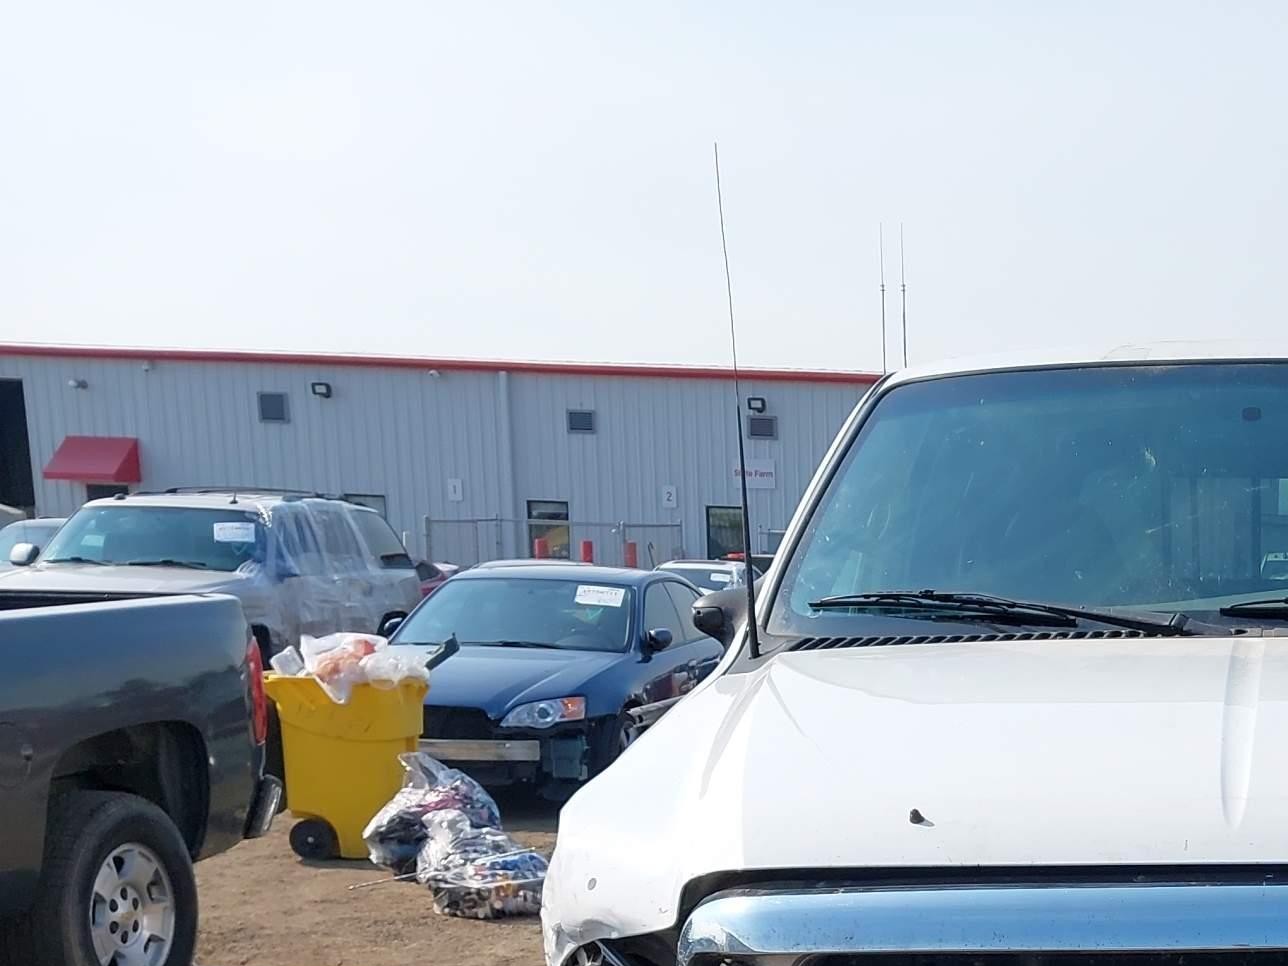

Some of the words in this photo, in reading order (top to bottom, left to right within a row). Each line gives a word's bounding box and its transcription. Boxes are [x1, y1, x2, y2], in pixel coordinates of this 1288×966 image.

[734, 469, 753, 477] Stte
[754, 470, 774, 478] Farm
[666, 491, 673, 502] 2
